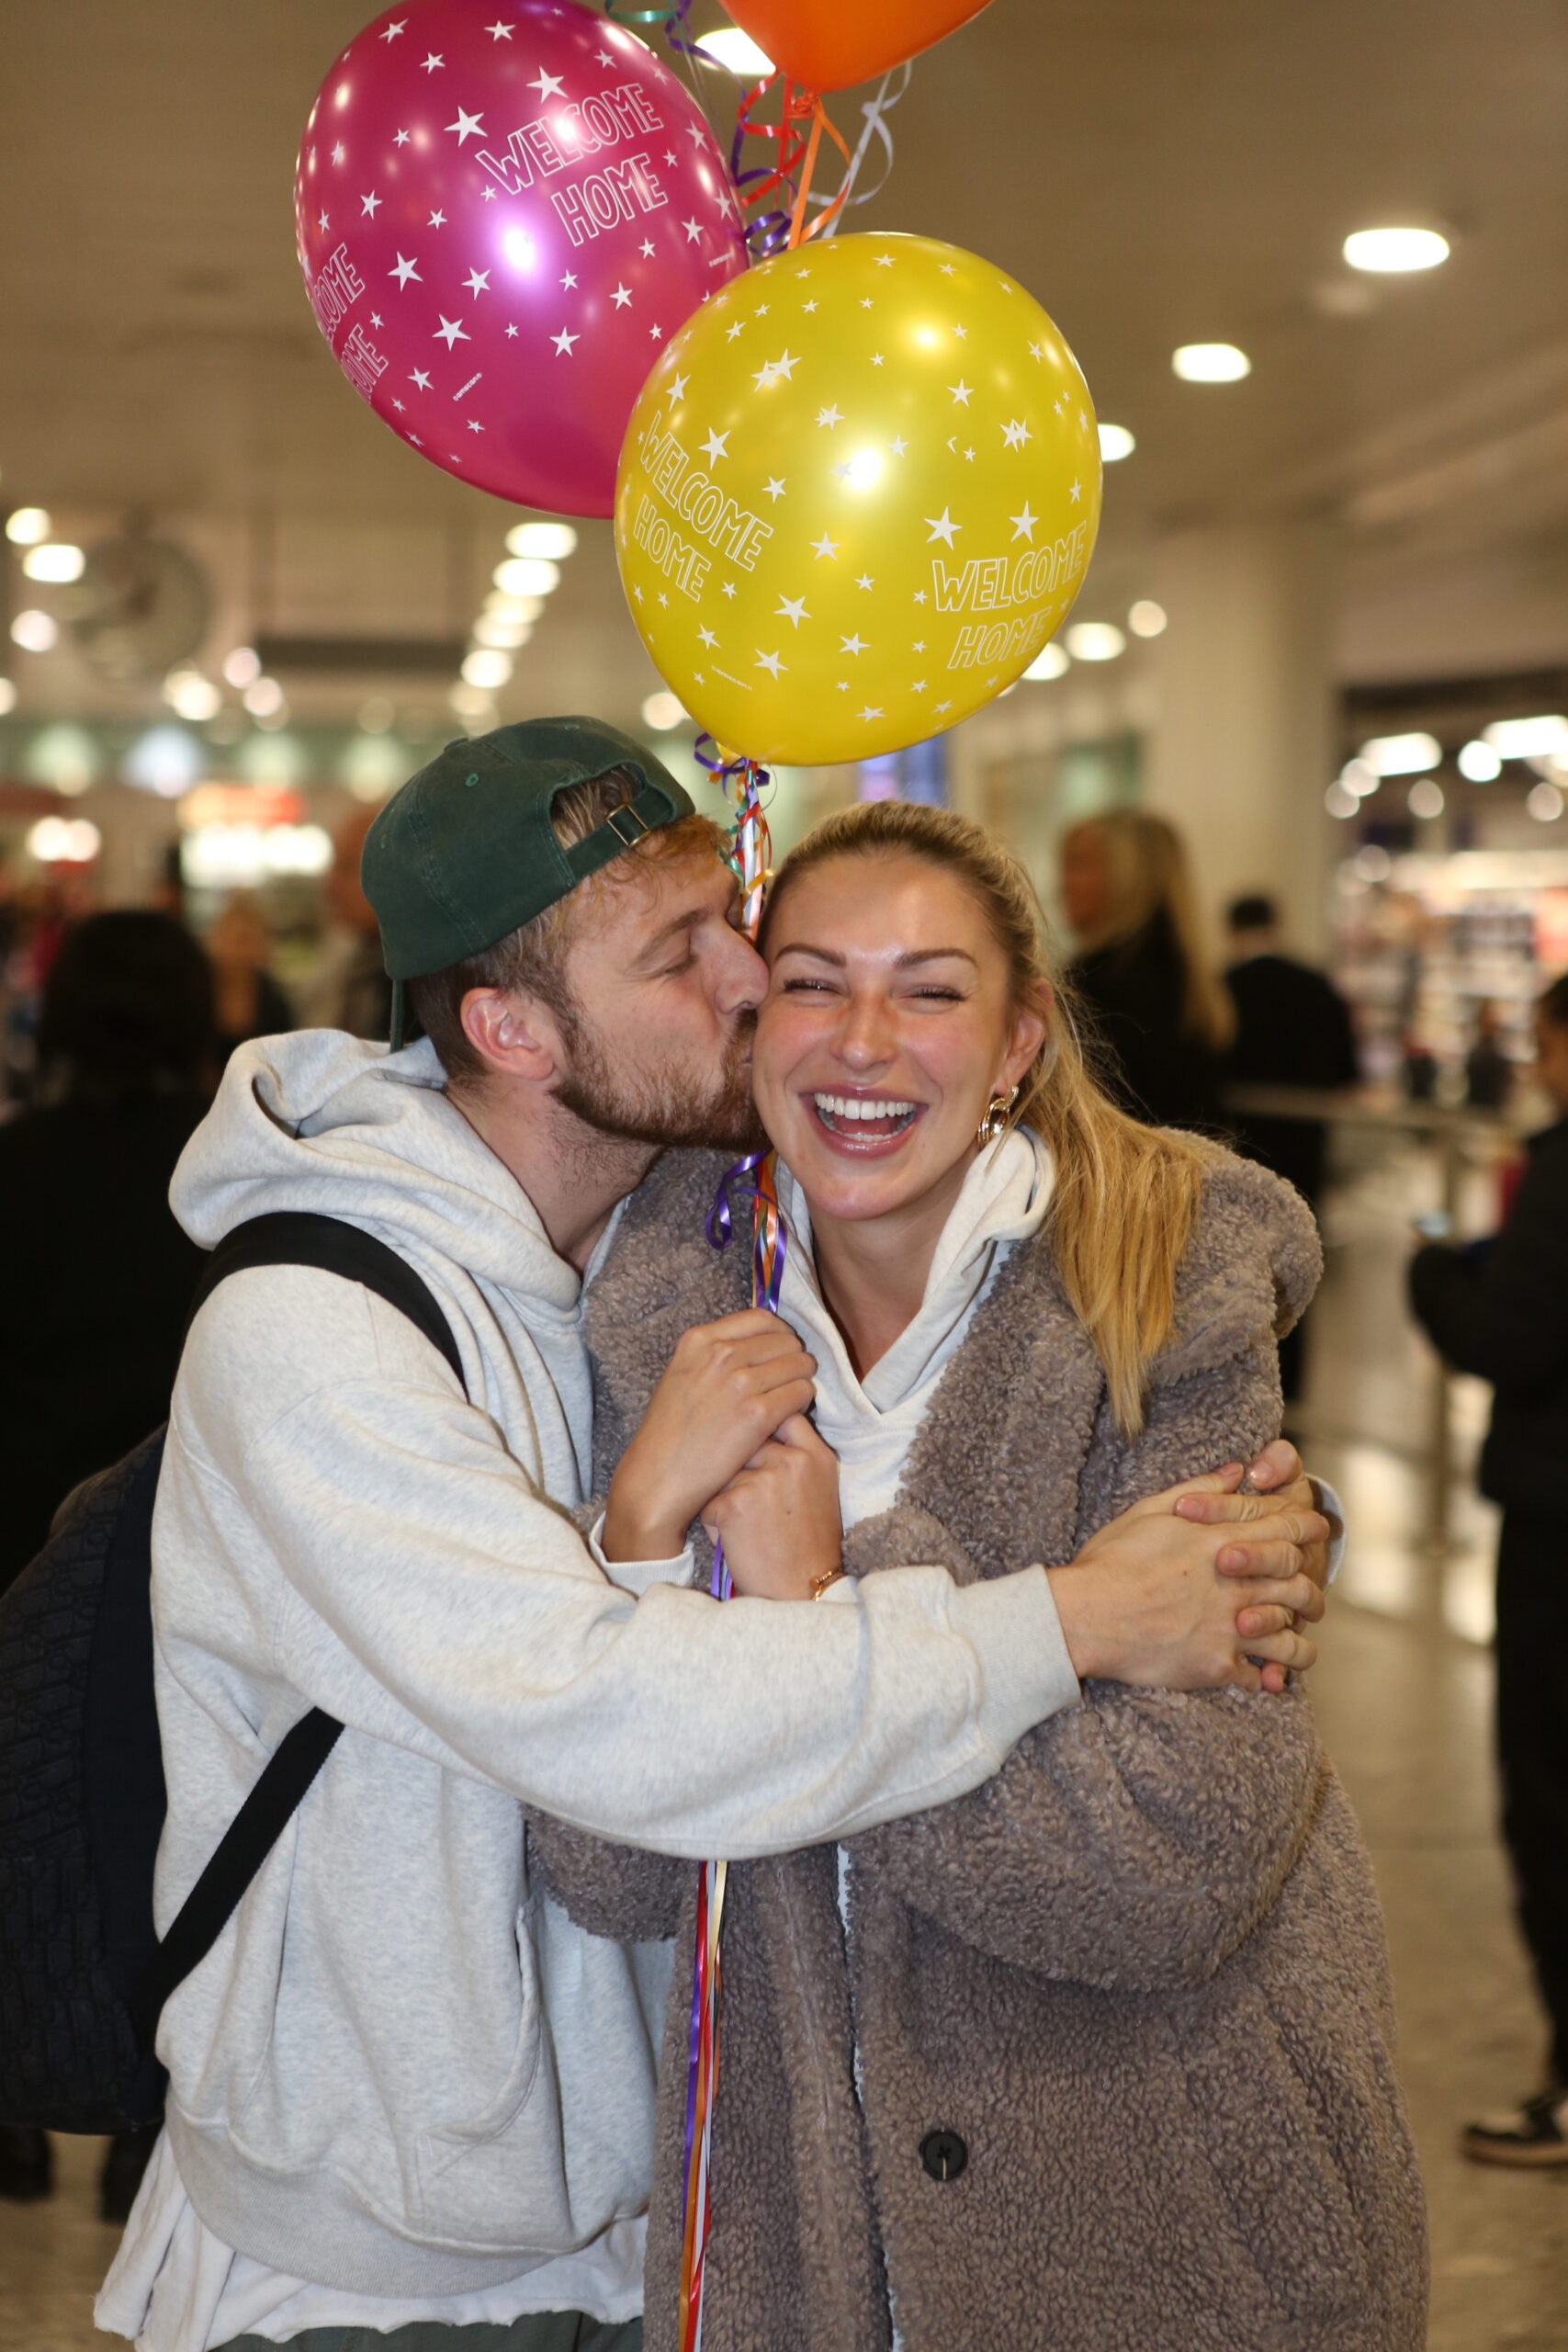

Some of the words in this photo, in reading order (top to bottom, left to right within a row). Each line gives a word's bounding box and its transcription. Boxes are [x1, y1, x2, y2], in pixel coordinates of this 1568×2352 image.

[475, 83, 664, 195] WELCOME
[551, 153, 669, 246] HOME
[341, 323, 389, 404] OME
[641, 410, 773, 571] WELCOME
[634, 493, 712, 603] HOME
[932, 520, 1087, 612] WELCOME
[947, 605, 1052, 669] HOME
